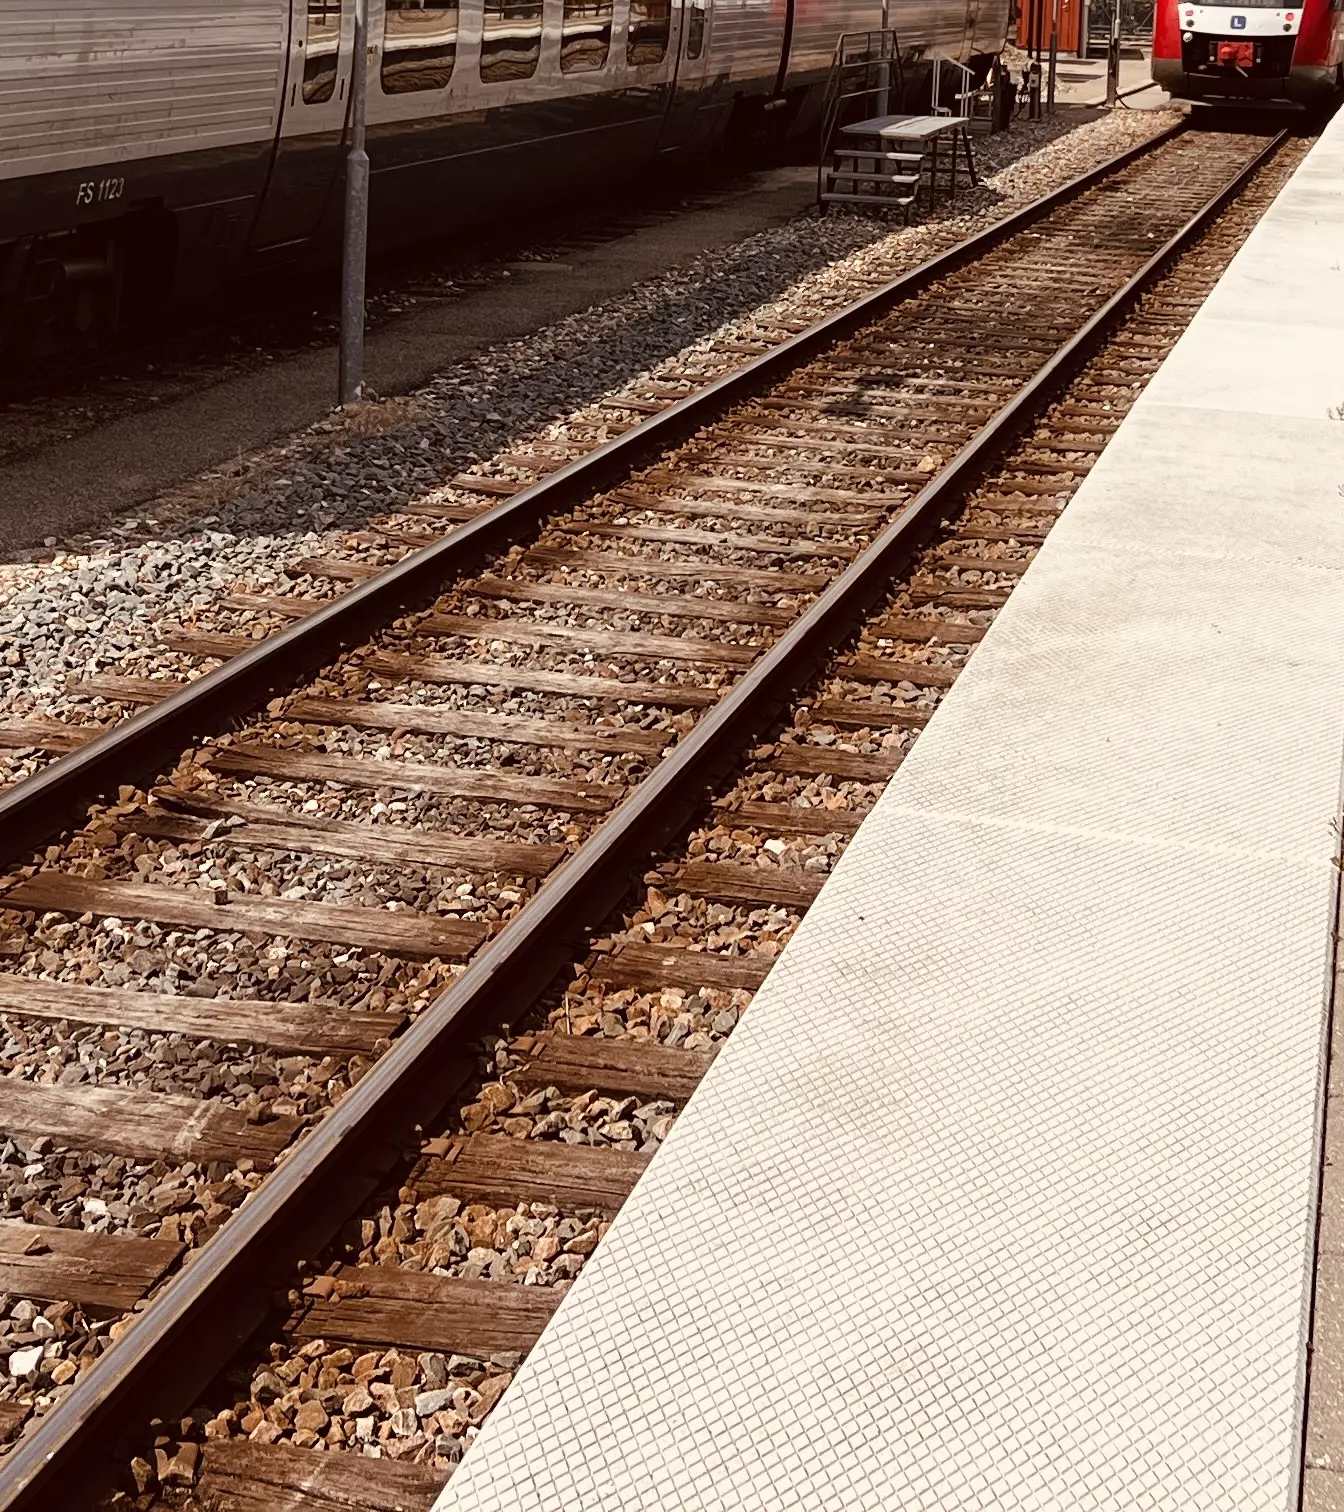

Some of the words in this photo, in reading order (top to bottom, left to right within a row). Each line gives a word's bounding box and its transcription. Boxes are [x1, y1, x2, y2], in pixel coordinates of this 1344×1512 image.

[1233, 17, 1242, 27] L
[76, 181, 95, 205] FS
[97, 177, 124, 201] 1123
